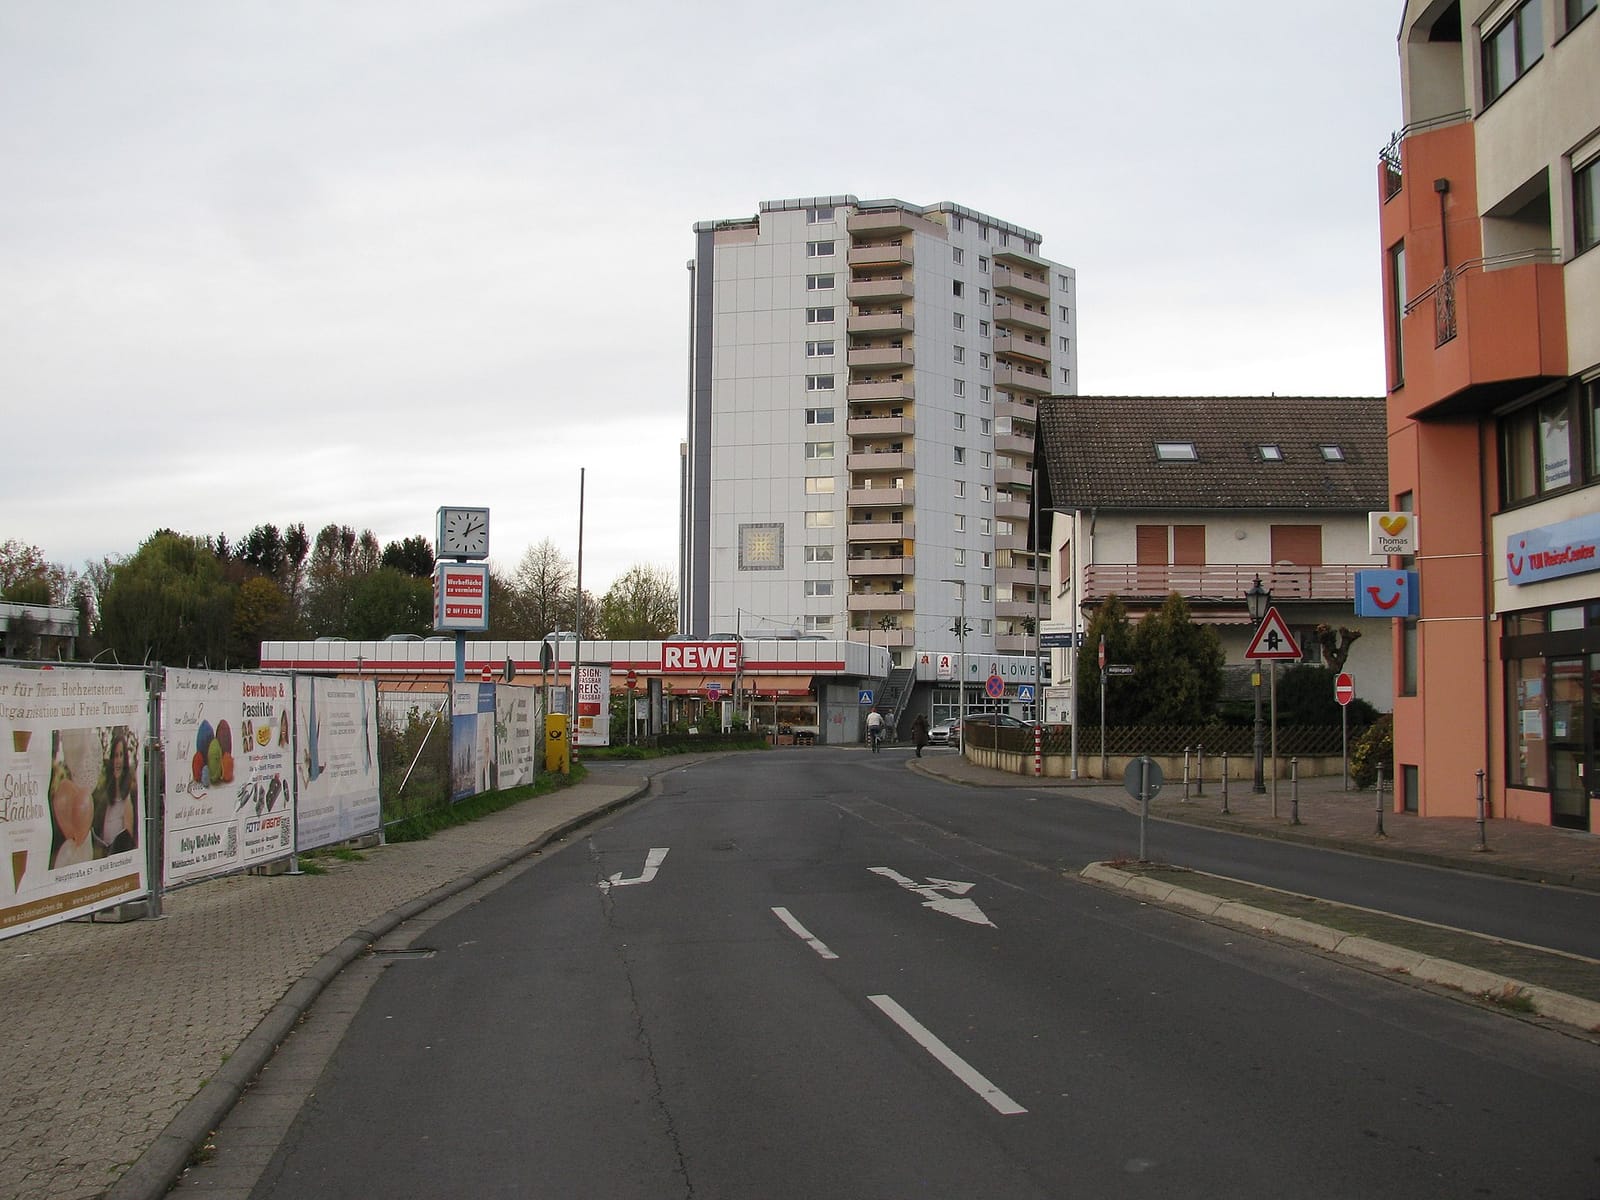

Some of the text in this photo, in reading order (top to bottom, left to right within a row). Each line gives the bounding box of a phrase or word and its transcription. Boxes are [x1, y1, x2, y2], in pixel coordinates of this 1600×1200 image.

[1378, 537, 1408, 545] Thomas
[1528, 552, 1544, 570] TUI
[1544, 545, 1596, 567] ReiseCenter
[447, 578, 482, 586] Werbefläche
[665, 646, 737, 669] REWE
[578, 669, 602, 678] ESIGN:
[13, 682, 34, 697] für
[578, 684, 601, 694] REIS:
[61, 703, 76, 716] und
[79, 702, 100, 716] Freie
[4, 772, 39, 799] Schoko
